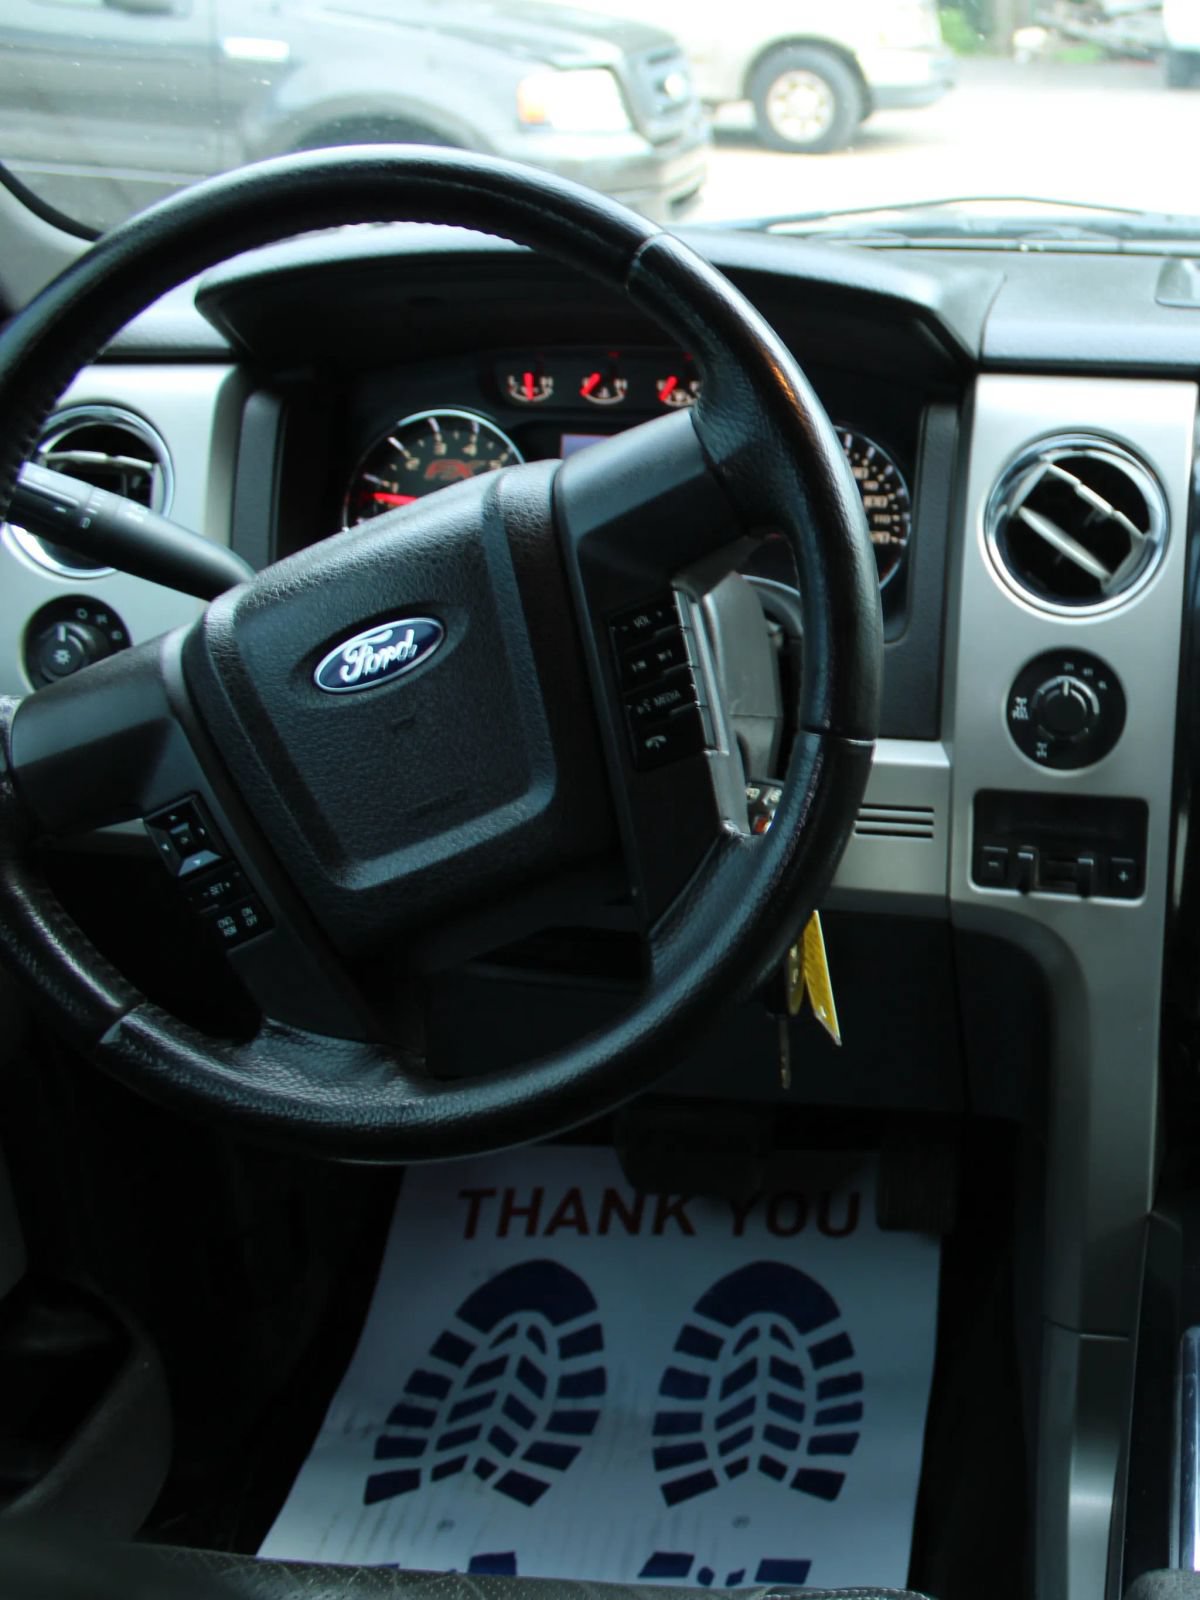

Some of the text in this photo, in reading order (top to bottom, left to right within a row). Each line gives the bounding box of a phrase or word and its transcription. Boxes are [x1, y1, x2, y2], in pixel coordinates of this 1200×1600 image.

[340, 629, 418, 683] Ford
[457, 1186, 861, 1240] THANK YOU
